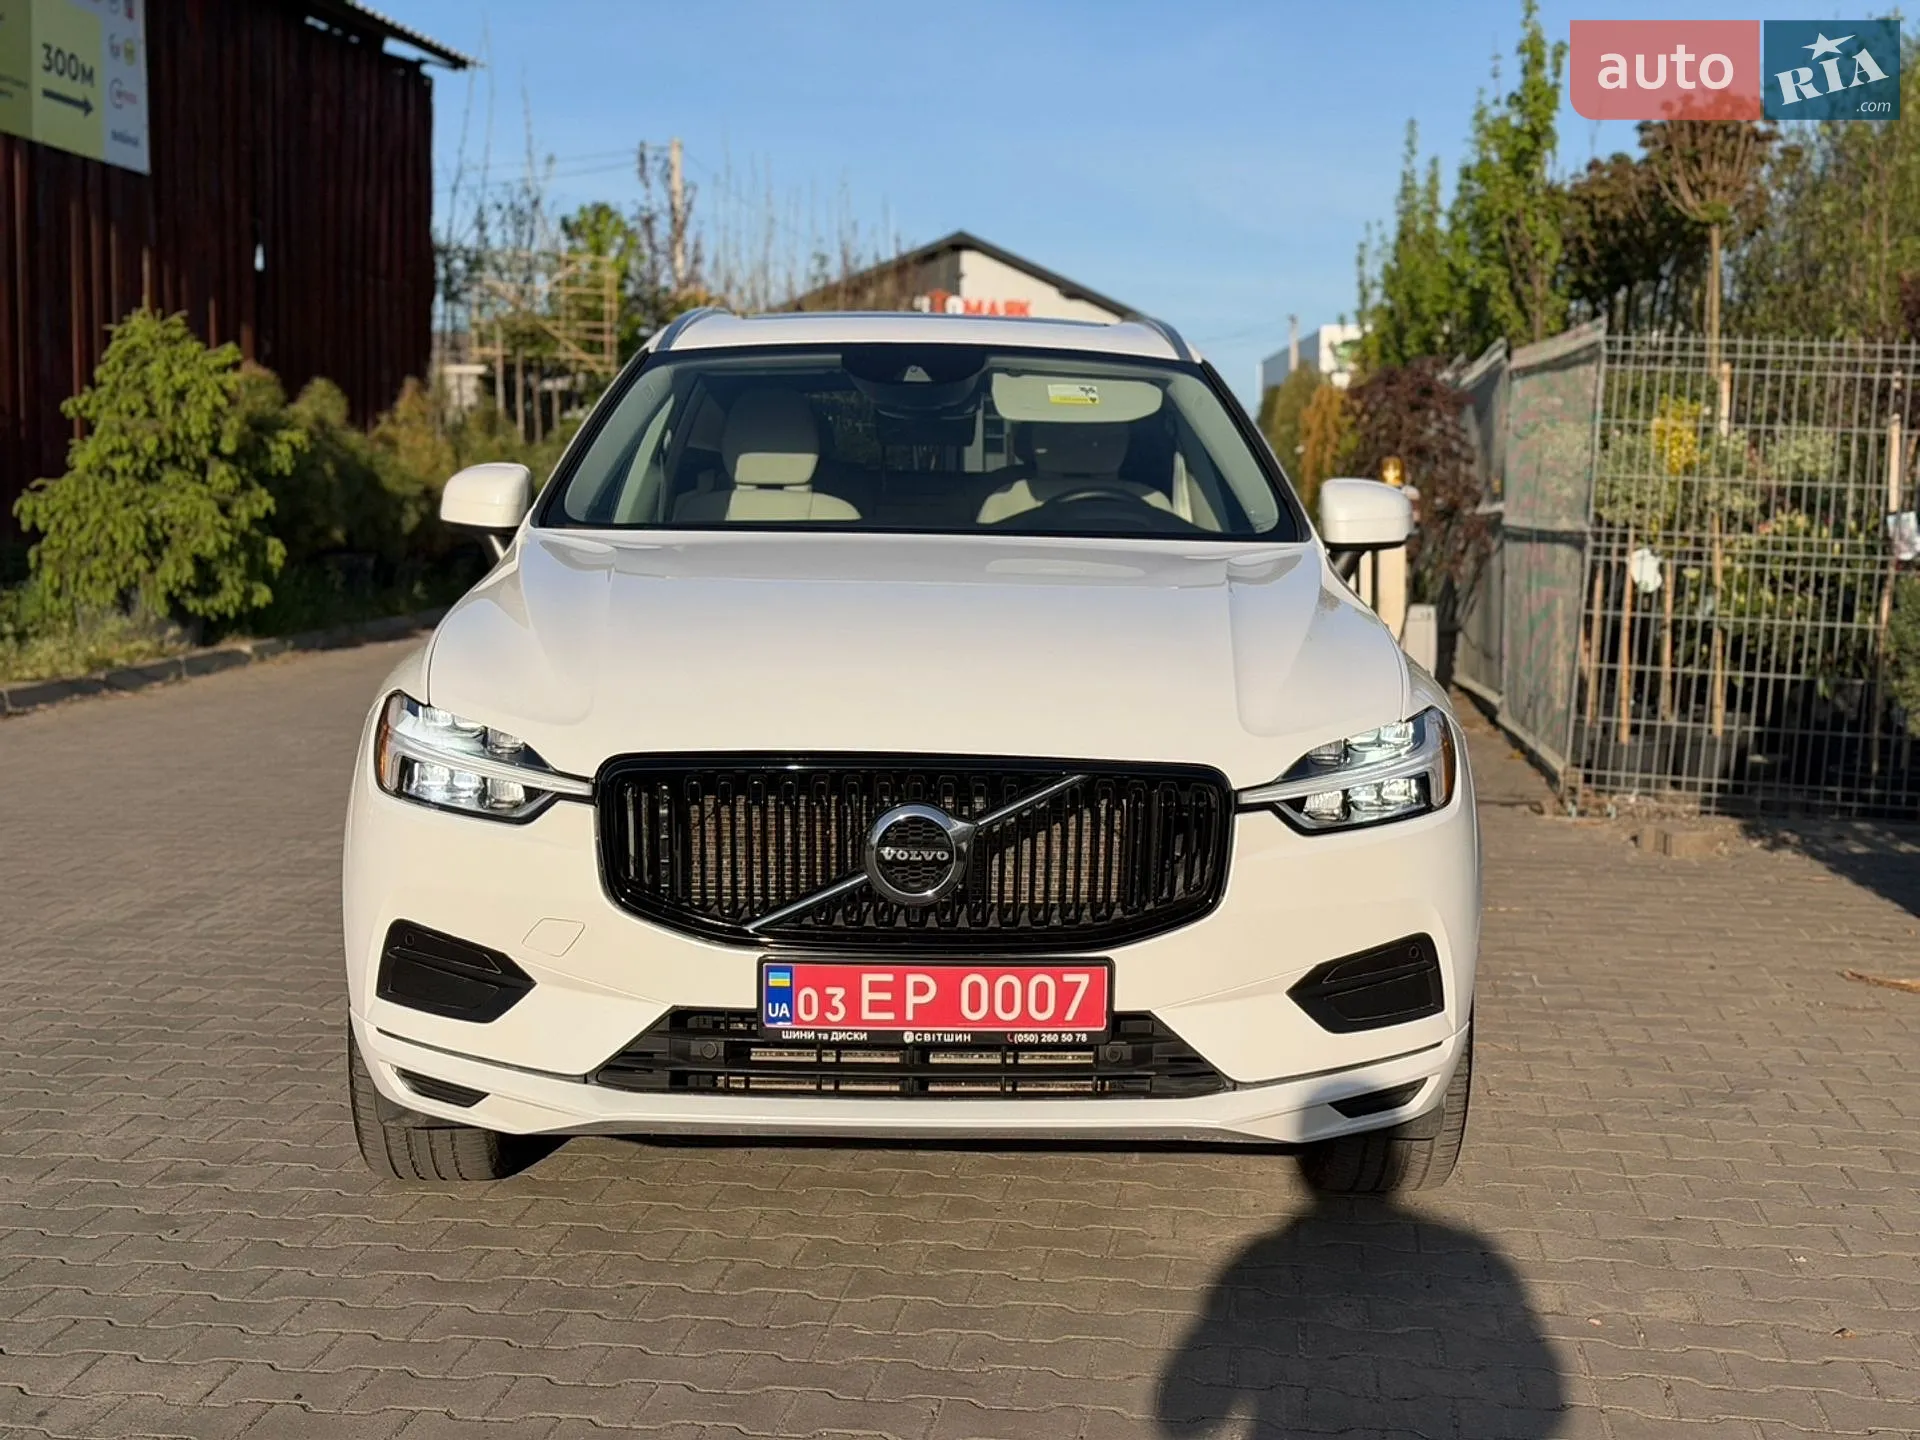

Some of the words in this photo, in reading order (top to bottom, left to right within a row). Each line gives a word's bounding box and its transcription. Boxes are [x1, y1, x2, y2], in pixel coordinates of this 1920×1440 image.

[880, 847, 949, 861] VOLVO
[797, 986, 847, 1023] 03
[860, 973, 938, 1021] EP
[960, 973, 1090, 1022] 0007
[768, 1003, 791, 1018] UA
[782, 1030, 815, 1042] ШИНИ
[830, 1032, 868, 1043] ДИСКИ
[1014, 1033, 1039, 1045] (050)
[1061, 1033, 1073, 1043] 50
[1075, 1033, 1088, 1043] 78
